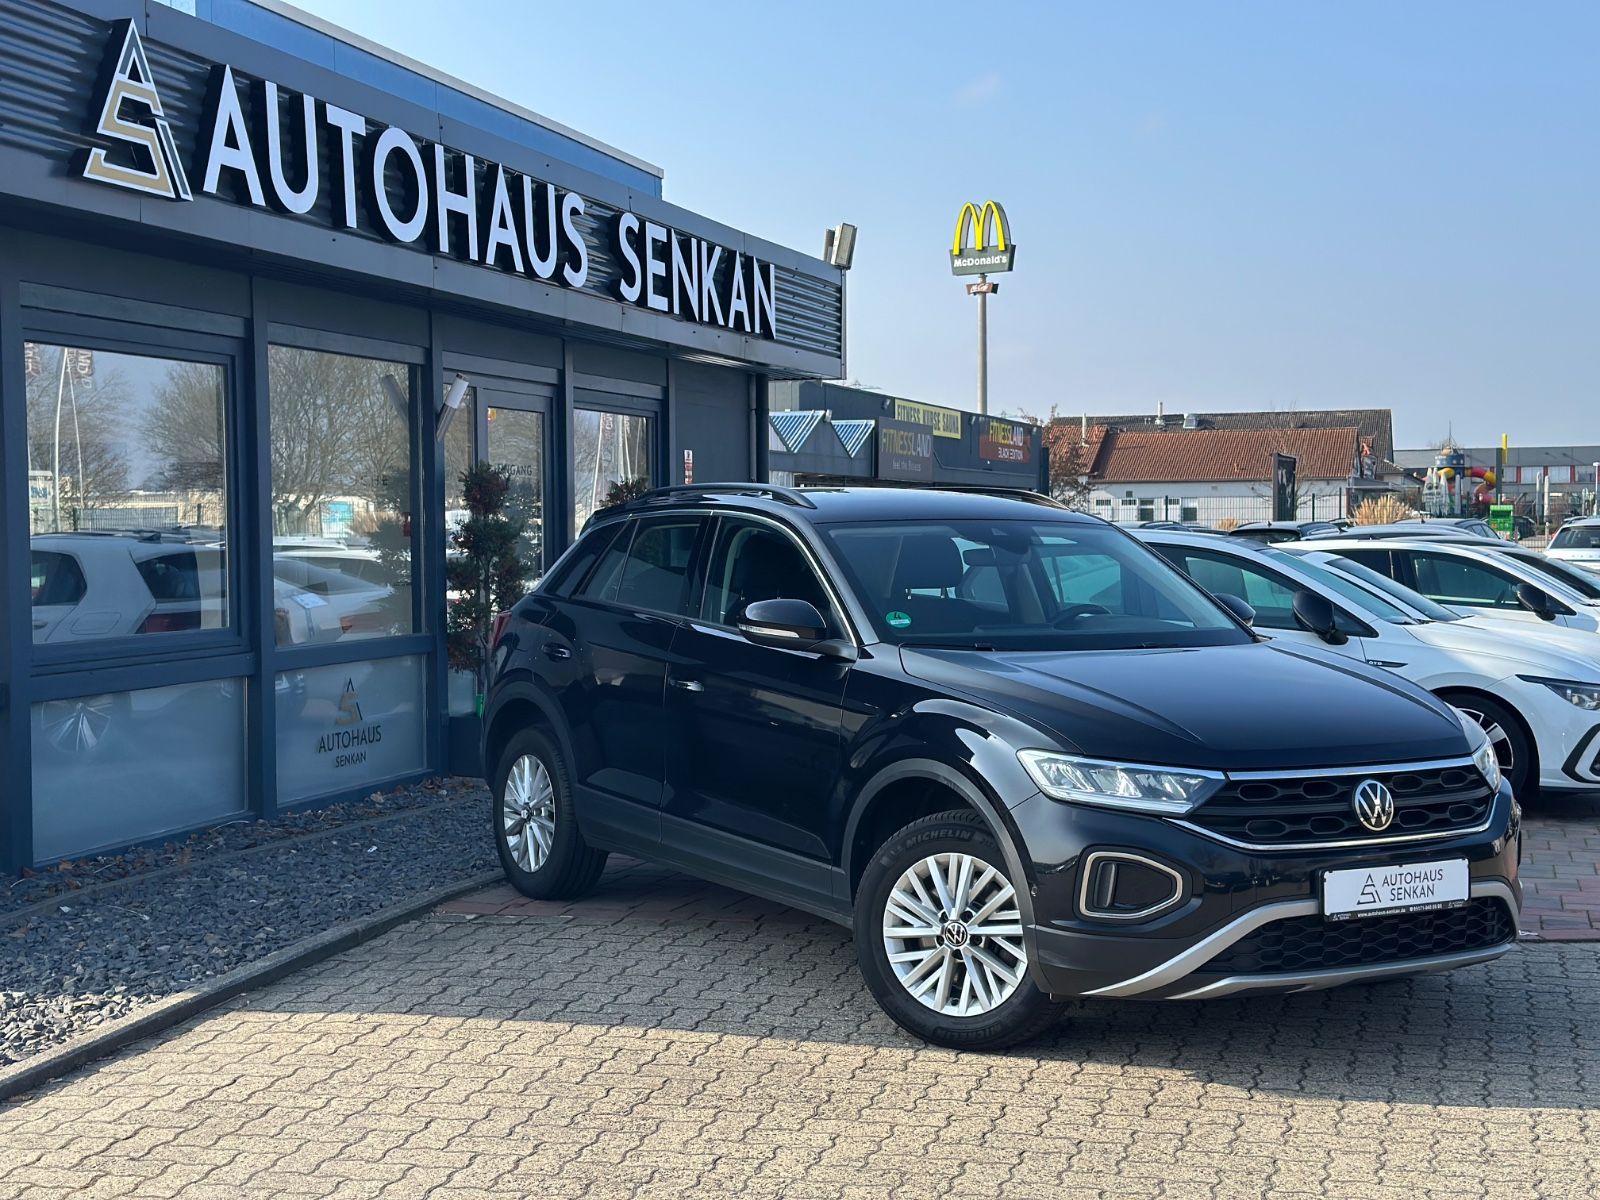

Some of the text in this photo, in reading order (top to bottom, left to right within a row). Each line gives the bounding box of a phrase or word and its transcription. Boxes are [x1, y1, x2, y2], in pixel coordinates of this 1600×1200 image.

[202, 63, 777, 340] AUTOHAUS SENKAN
[953, 255, 1007, 268] McDonald's
[881, 429, 931, 457] FITNESSLAND
[989, 421, 1023, 446] FITNESSLAND
[318, 725, 382, 754] AUTOHAUS
[335, 751, 367, 768] SENKAN
[906, 829, 971, 848] MICHELIN
[1381, 868, 1444, 888] AUTOHAUS
[1389, 884, 1435, 902] SENKAN
